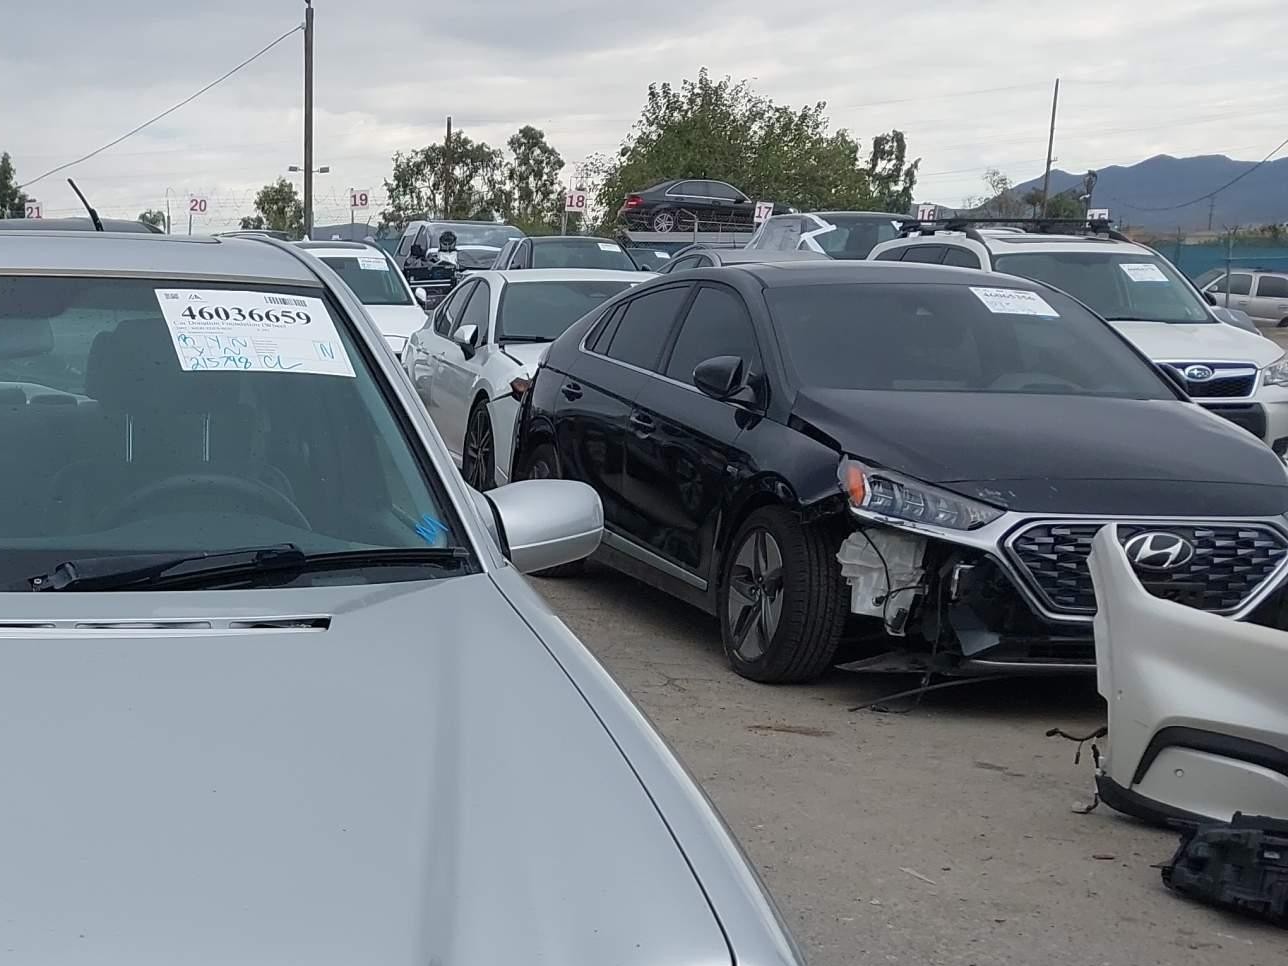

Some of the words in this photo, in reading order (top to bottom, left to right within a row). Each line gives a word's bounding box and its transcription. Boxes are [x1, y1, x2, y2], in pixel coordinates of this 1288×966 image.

[190, 199, 207, 212] 20
[351, 193, 368, 207] 19
[566, 194, 585, 208] 18
[26, 206, 42, 219] 21
[755, 206, 772, 219] 17
[181, 305, 311, 325] 46036659
[320, 341, 334, 359] N
